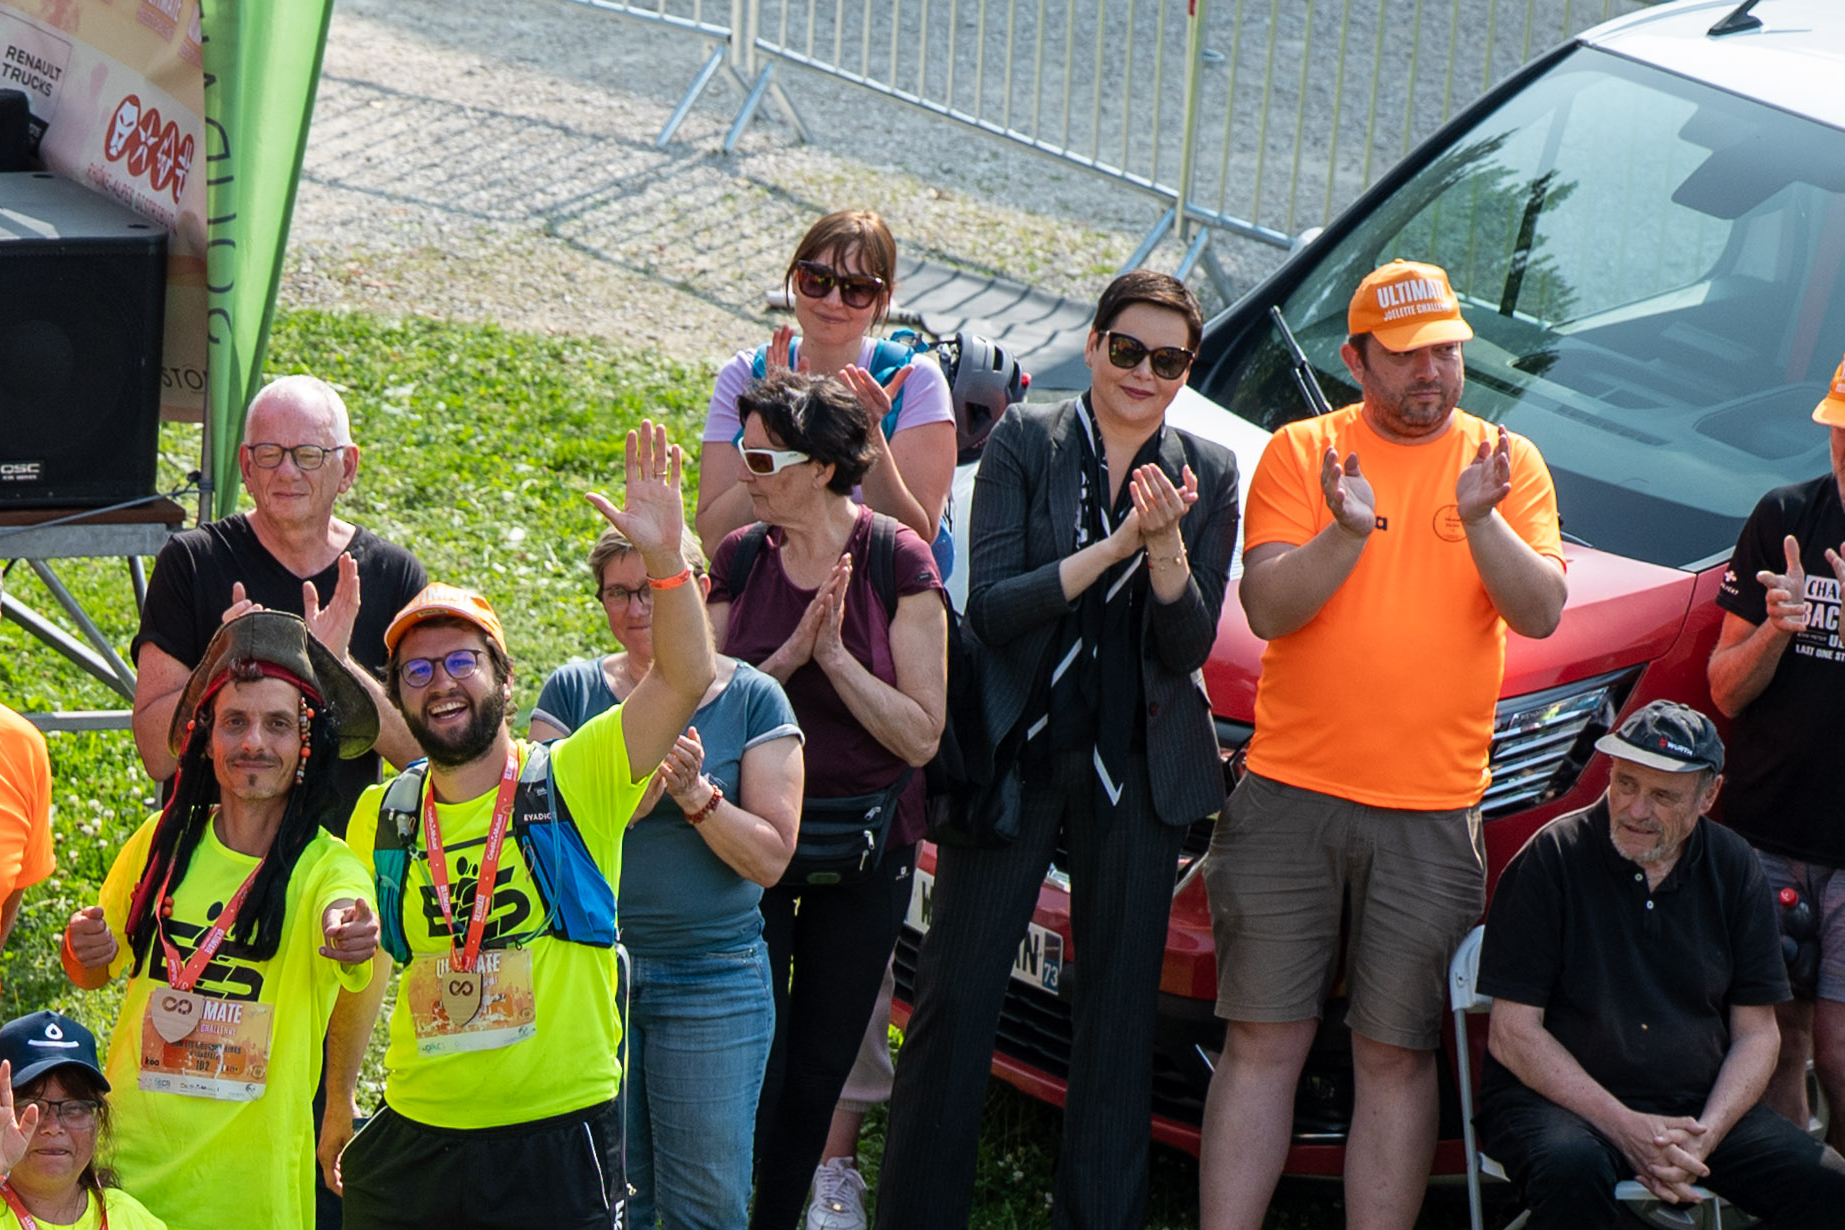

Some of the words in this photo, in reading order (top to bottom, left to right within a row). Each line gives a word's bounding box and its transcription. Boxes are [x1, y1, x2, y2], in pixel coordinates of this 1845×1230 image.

[5, 45, 63, 82] RENAULT
[2, 62, 53, 97] TRUCKS
[0, 463, 40, 474] QSC
[1808, 579, 1839, 600] CHA
[524, 812, 552, 822] EVADIC
[1044, 963, 1059, 987] 73
